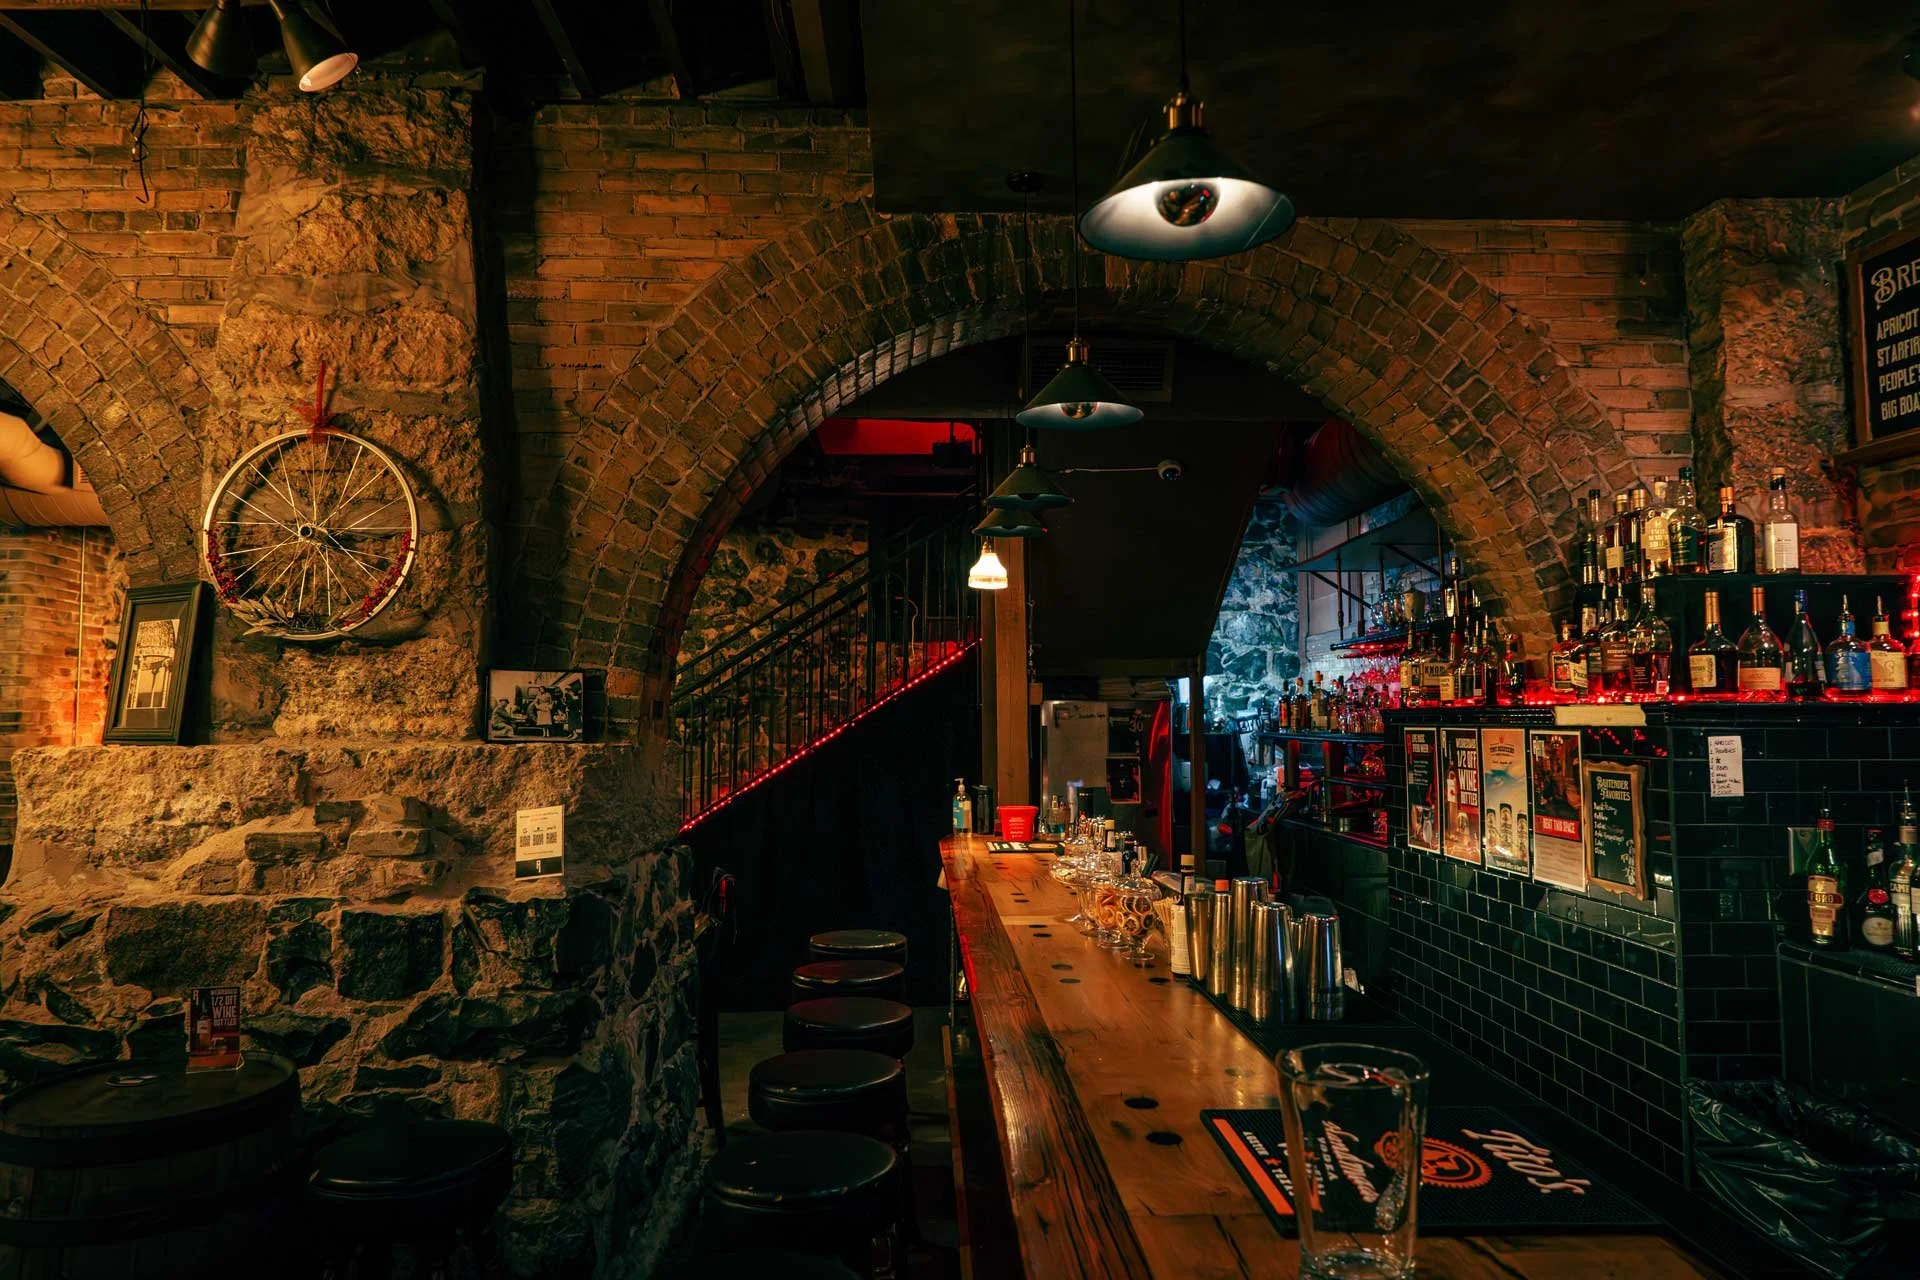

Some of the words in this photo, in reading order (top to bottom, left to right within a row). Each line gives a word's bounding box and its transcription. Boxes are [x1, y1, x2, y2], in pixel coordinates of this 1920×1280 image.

[1876, 308, 1920, 342] APRICOT
[1880, 398, 1898, 421] BIG
[1899, 392, 1920, 417] BOA
[1458, 769, 1478, 792] WINE
[212, 1006, 238, 1019] WINE
[1460, 1128, 1592, 1196] Tito's
